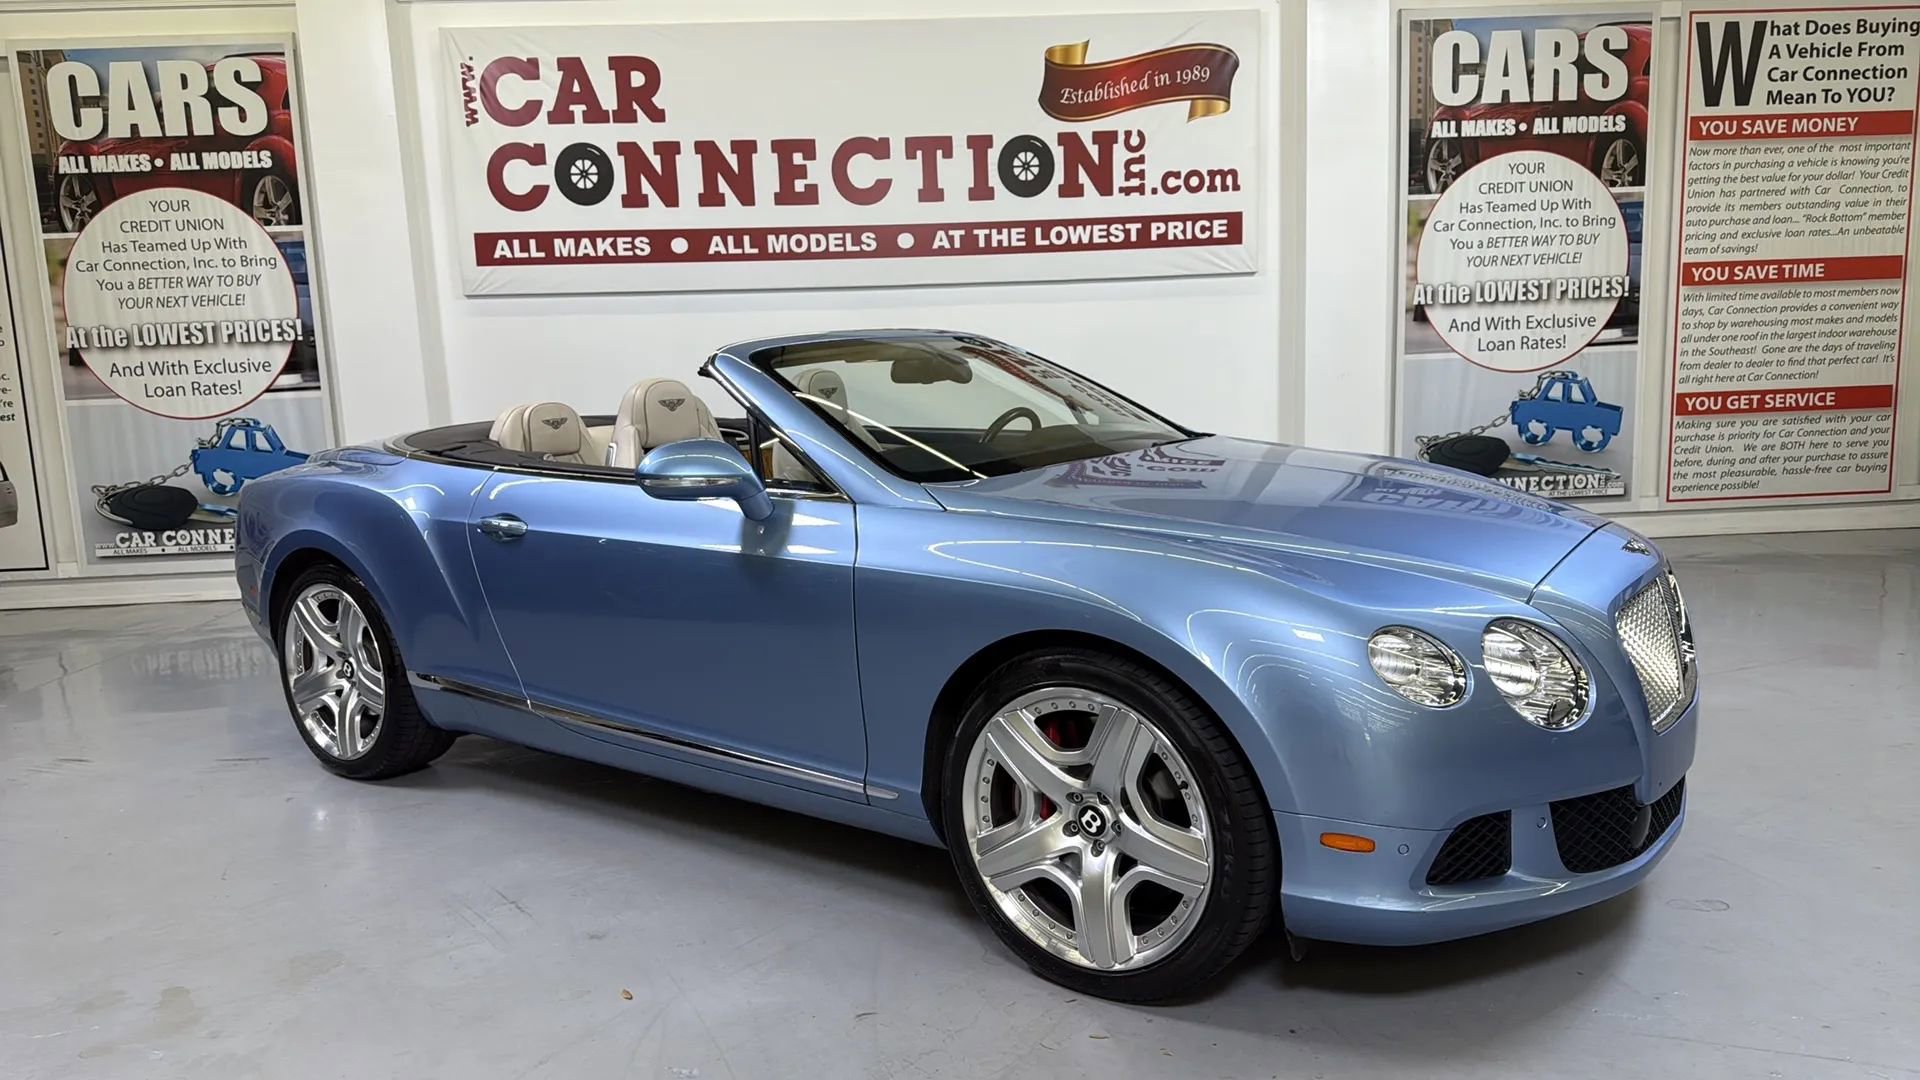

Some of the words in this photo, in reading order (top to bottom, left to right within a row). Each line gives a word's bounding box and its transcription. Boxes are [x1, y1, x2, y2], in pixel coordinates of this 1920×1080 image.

[1805, 20, 1851, 36] Does
[1856, 18, 1920, 38] Buying
[1768, 45, 1781, 59] A
[1786, 42, 1852, 59] Vehicle
[1857, 42, 1905, 57] From
[1432, 26, 1628, 107] CARS
[1767, 68, 1798, 82] Car
[1802, 65, 1908, 81] Connection
[479, 56, 666, 128] CAR
[1060, 68, 1151, 105] Established
[1154, 69, 1171, 88] in
[1176, 66, 1210, 85] 1989
[46, 57, 268, 141] CARS
[1766, 90, 1817, 105] Mean
[1821, 89, 1842, 104] To
[1847, 87, 1895, 103] YOU?
[1431, 121, 1458, 138] ALL
[1461, 118, 1516, 137] MAKES
[1533, 117, 1560, 134] ALL
[1562, 115, 1626, 133] MODELS
[1700, 121, 1737, 136] YOU
[1742, 119, 1787, 134] SAVE
[1792, 117, 1858, 133] MONEY
[58, 157, 88, 174] ALL
[92, 154, 152, 172] MAKES
[170, 153, 200, 171] ALL
[203, 150, 272, 170] MODELS
[486, 129, 1118, 212] CONNECTION
[1150, 167, 1241, 195] .com
[1509, 163, 1545, 175] YOUR
[1688, 175, 1720, 186] getting
[1723, 175, 1738, 184] the
[1740, 174, 1759, 183] best
[1761, 173, 1786, 182] value
[1788, 172, 1800, 182] for
[1802, 173, 1823, 183] your
[1826, 171, 1855, 181] dollar!
[1859, 171, 1880, 180] Your
[1881, 169, 1909, 179] Credit
[1479, 182, 1526, 194] CREDIT
[1529, 180, 1573, 193] UNION
[149, 200, 191, 213] YOUR
[1460, 201, 1483, 214] Has
[1486, 200, 1536, 213] Teamed
[1540, 200, 1558, 213] Up
[1562, 198, 1591, 210] With
[120, 220, 171, 233] CREDIT
[175, 219, 224, 231] UNION
[1433, 221, 1454, 232] Car
[1458, 218, 1536, 232] Connection,
[1540, 217, 1562, 228] Inc.
[1566, 217, 1578, 227] to
[1583, 215, 1616, 228] Bring
[932, 230, 966, 249] AT
[973, 228, 1025, 248] THE
[1035, 223, 1142, 246] LOWEST
[1150, 219, 1228, 241] PRICE
[1450, 238, 1474, 250] You
[1477, 240, 1484, 249] a
[1486, 236, 1528, 248] BETTER
[1531, 236, 1557, 247] WAY
[1559, 235, 1575, 246] TO
[1576, 233, 1600, 245] BUY
[102, 241, 127, 254] Has
[130, 239, 187, 252] Teamed
[191, 239, 211, 252] Up
[215, 238, 247, 249] With
[494, 239, 545, 259] ALL
[553, 237, 651, 258] MAKES
[708, 235, 759, 254] ALL
[767, 231, 877, 253] MODELS
[76, 260, 99, 272] Car
[103, 258, 189, 272] Connection,
[193, 257, 218, 269] Inc.
[222, 257, 236, 268] to
[240, 255, 277, 269] Bring
[1467, 256, 1499, 267] YOUR
[1500, 254, 1531, 266] NEXT
[1533, 252, 1582, 265] VEHICLE!
[1691, 267, 1729, 281] YOU
[1734, 265, 1778, 280] SAVE
[1783, 263, 1825, 278] TIME
[96, 279, 123, 291] You
[128, 282, 134, 290] a
[138, 277, 184, 290] BETTER
[187, 277, 215, 289] WAY
[217, 276, 234, 288] TO
[236, 275, 262, 287] BUY
[1413, 284, 1433, 306] At
[1438, 283, 1471, 304] the
[1475, 279, 1551, 303] LOWEST
[1556, 275, 1629, 300] PRICES!
[118, 297, 153, 309] YOUR
[156, 296, 189, 308] NEXT
[191, 294, 246, 307] VEHICLE!
[1449, 318, 1480, 332] And
[1485, 317, 1521, 331] With
[1526, 314, 1596, 329] Exclusive
[1681, 322, 1691, 330] to
[1693, 321, 1715, 331] shop
[1717, 320, 1728, 330] by
[1730, 318, 1788, 329] warehousing
[1790, 318, 1813, 326] most
[1815, 316, 1844, 325] makes
[1846, 315, 1864, 324] and
[1866, 314, 1898, 323] models
[66, 327, 89, 349] At
[93, 326, 127, 347] the
[132, 322, 215, 346] LOWEST
[220, 319, 303, 343] PRICES!
[1478, 338, 1516, 352] Loan
[1521, 335, 1566, 349] Rates!
[110, 362, 145, 378] And
[148, 361, 188, 376] With
[194, 358, 271, 375] Exclusive
[1679, 374, 1690, 384] all
[1692, 374, 1713, 385] right
[1715, 373, 1734, 383] here
[1736, 374, 1745, 382] at
[1747, 372, 1763, 381] Car
[1765, 370, 1818, 380] Connection!
[144, 383, 186, 398] Loan
[191, 380, 242, 396] Rates!
[1685, 396, 1722, 411] YOU
[1726, 395, 1761, 409] GET
[1764, 392, 1836, 408] SERVICE
[1674, 432, 1715, 443] purchase
[1718, 432, 1725, 441] is
[1728, 431, 1760, 441] priority
[1763, 430, 1776, 440] for
[1779, 429, 1794, 438] Car
[1797, 427, 1847, 437] Connection
[1850, 426, 1868, 435] and
[1869, 427, 1890, 436] your
[1497, 474, 1600, 491] NNECTION
[116, 532, 156, 548] CAR
[162, 529, 235, 545] CONNE
[1081, 810, 1102, 833] B
